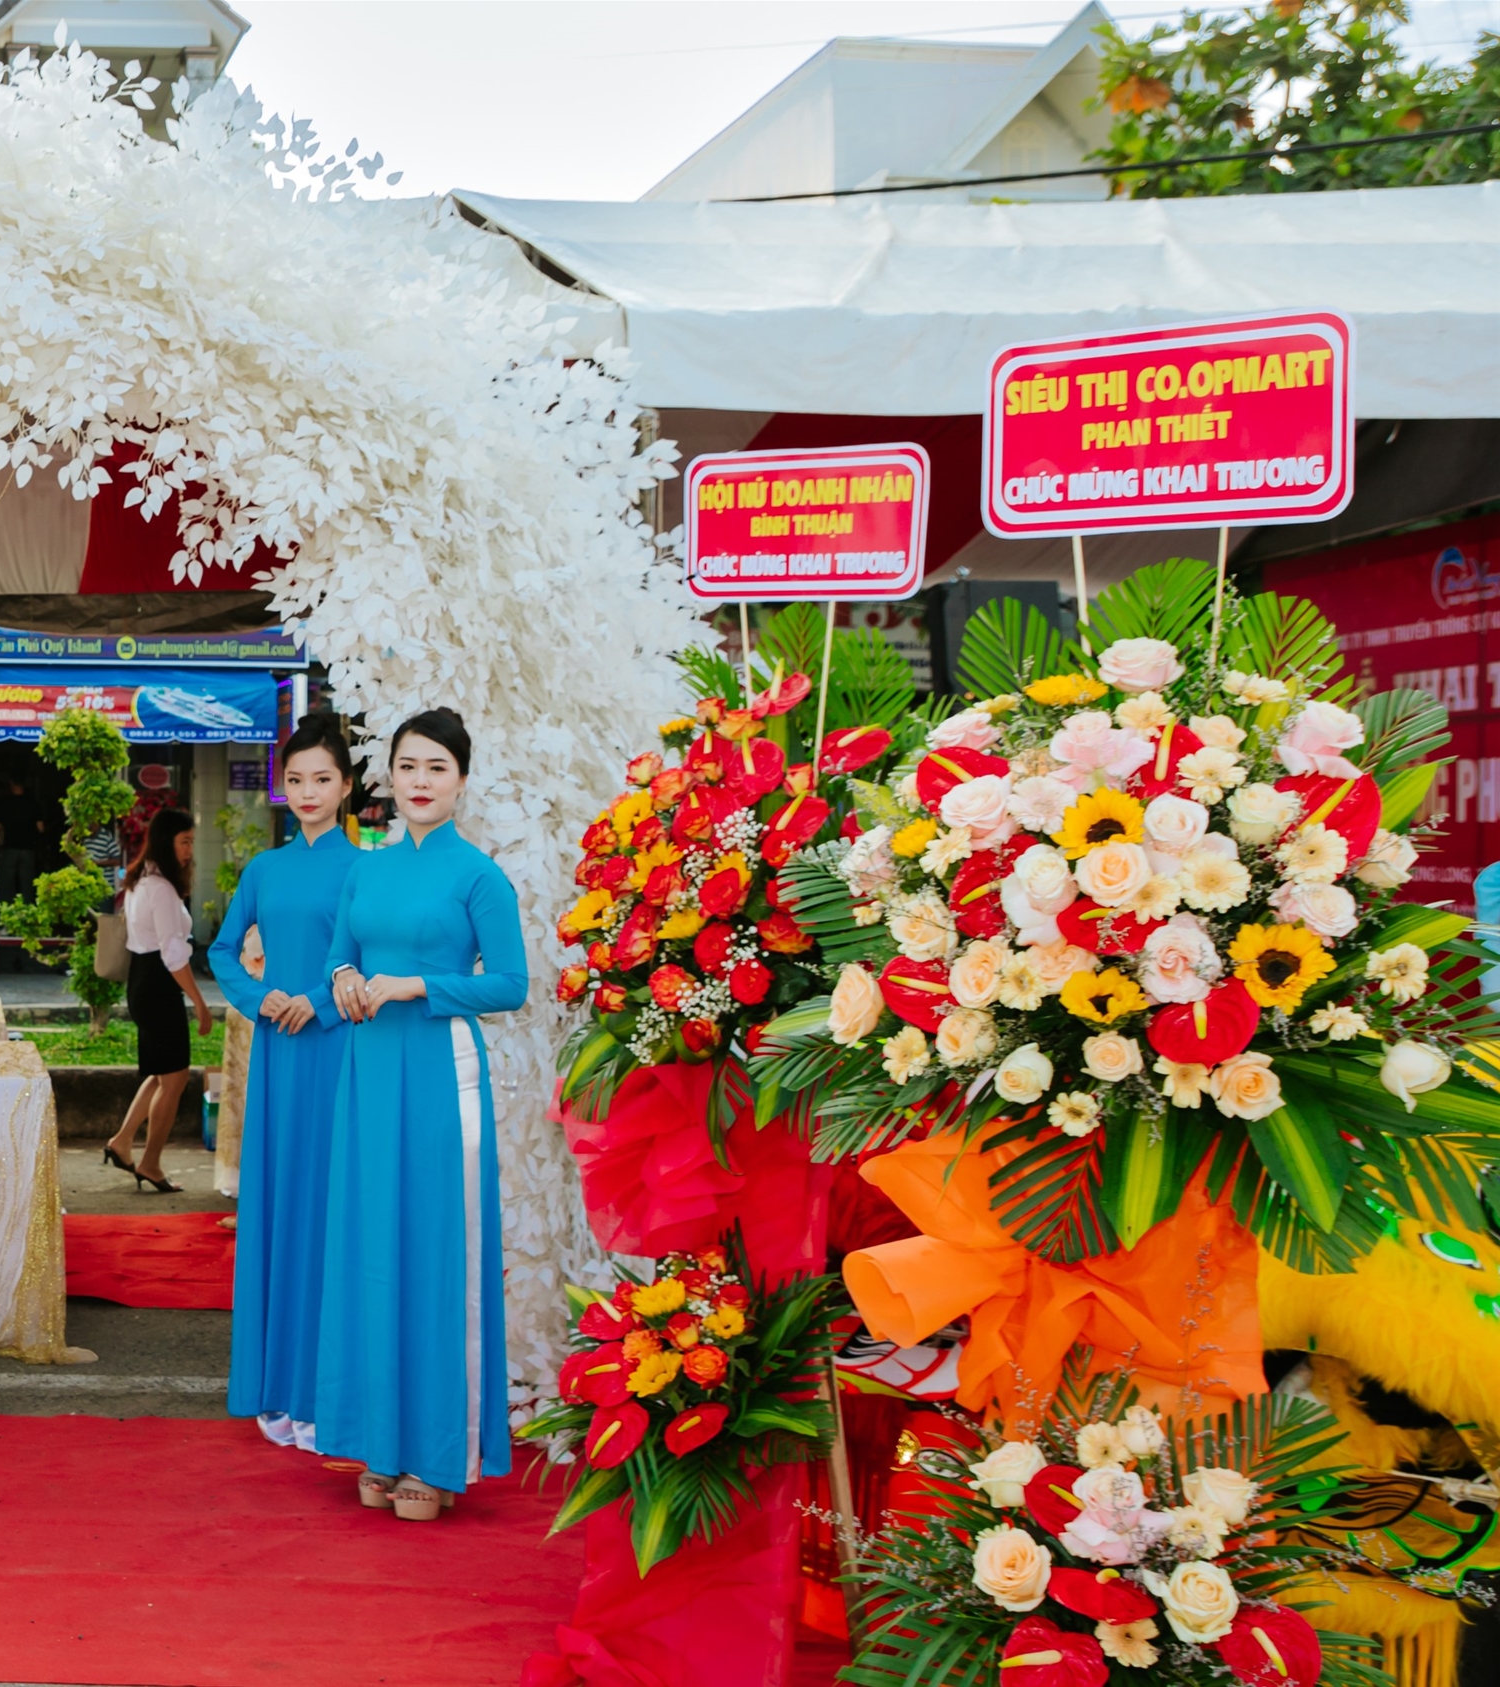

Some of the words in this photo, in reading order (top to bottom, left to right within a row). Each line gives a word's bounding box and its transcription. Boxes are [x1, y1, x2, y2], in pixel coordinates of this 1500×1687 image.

[1005, 373, 1069, 416] SIÊU
[1076, 370, 1129, 412] THỊ
[1135, 349, 1331, 403] CO.OPMART
[1081, 417, 1151, 451] PHAN
[1155, 403, 1233, 444] THIẾT
[698, 479, 734, 514] HỘI
[738, 476, 769, 509] NỮ
[771, 477, 846, 507] DOANH
[849, 470, 913, 504] NHÂN
[1004, 471, 1063, 505] CHÚC
[1068, 466, 1139, 502] MỪNG
[1142, 463, 1207, 496] KHAI
[1214, 455, 1324, 491] TRƯƠNG
[750, 512, 790, 537] BÌNH
[792, 509, 854, 538] THUẬN
[699, 552, 738, 578] CHÚC
[788, 553, 831, 576] KHAI
[41, 638, 65, 657] Quý
[67, 638, 101, 654] Island
